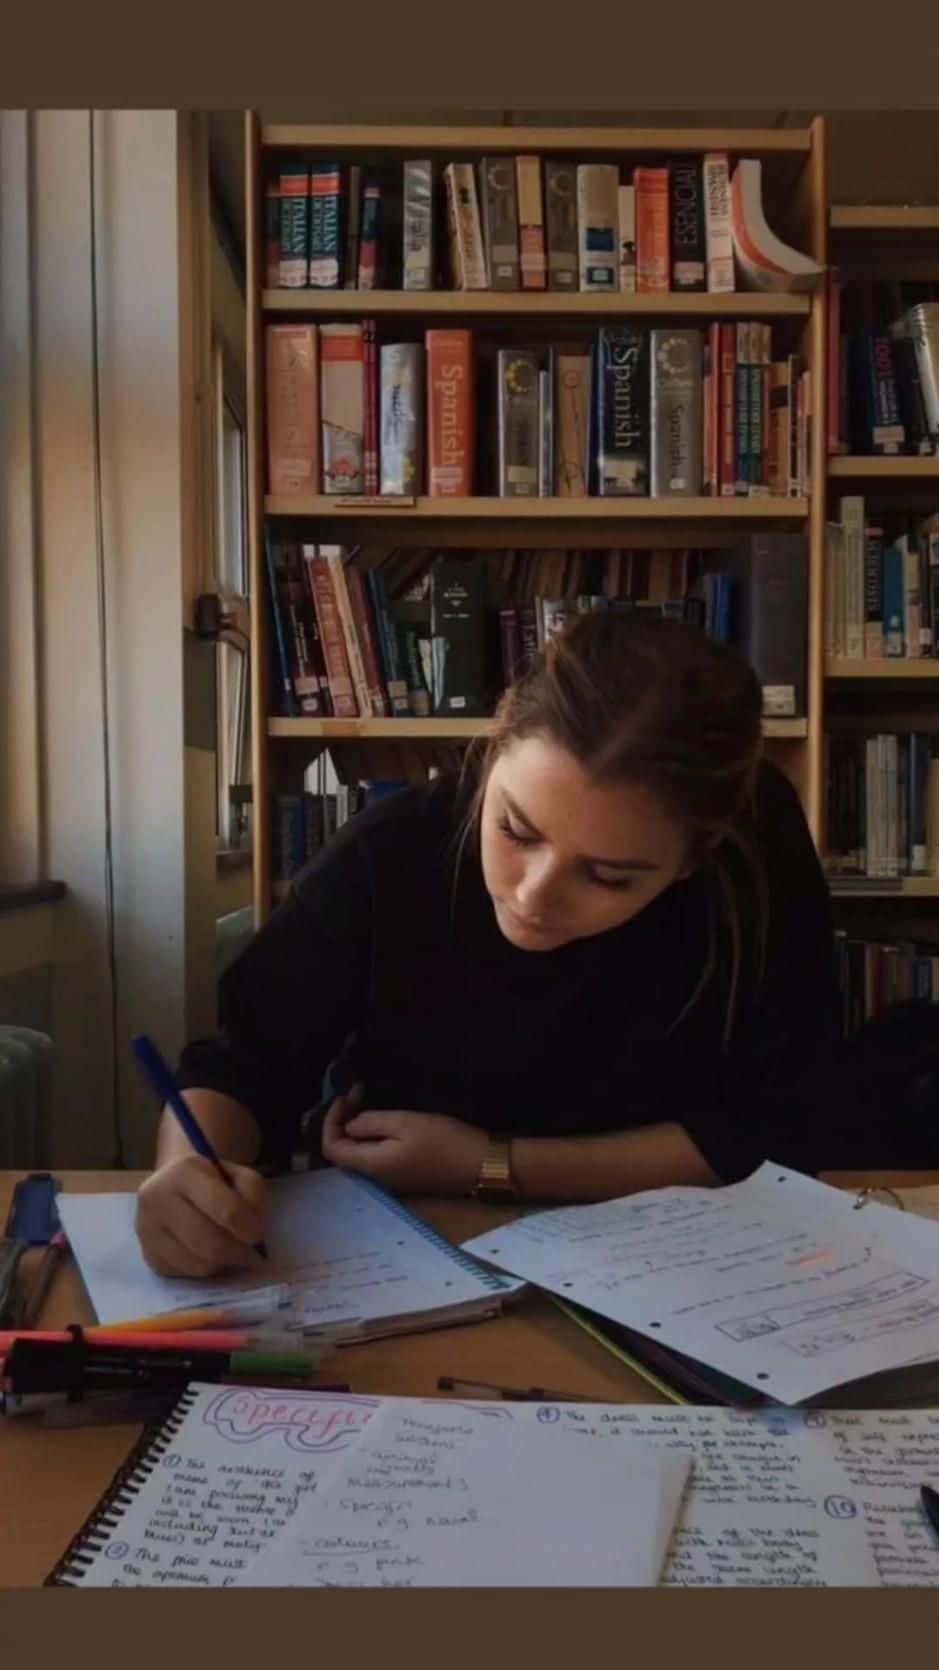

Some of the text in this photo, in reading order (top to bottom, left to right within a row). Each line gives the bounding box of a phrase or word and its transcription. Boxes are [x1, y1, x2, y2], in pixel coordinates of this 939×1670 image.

[292, 198, 307, 254] ITALIAN
[323, 197, 338, 253] ITALIAN
[435, 363, 465, 465] Spanish
[606, 346, 641, 448] Spanish
[667, 405, 688, 466] Spanish
